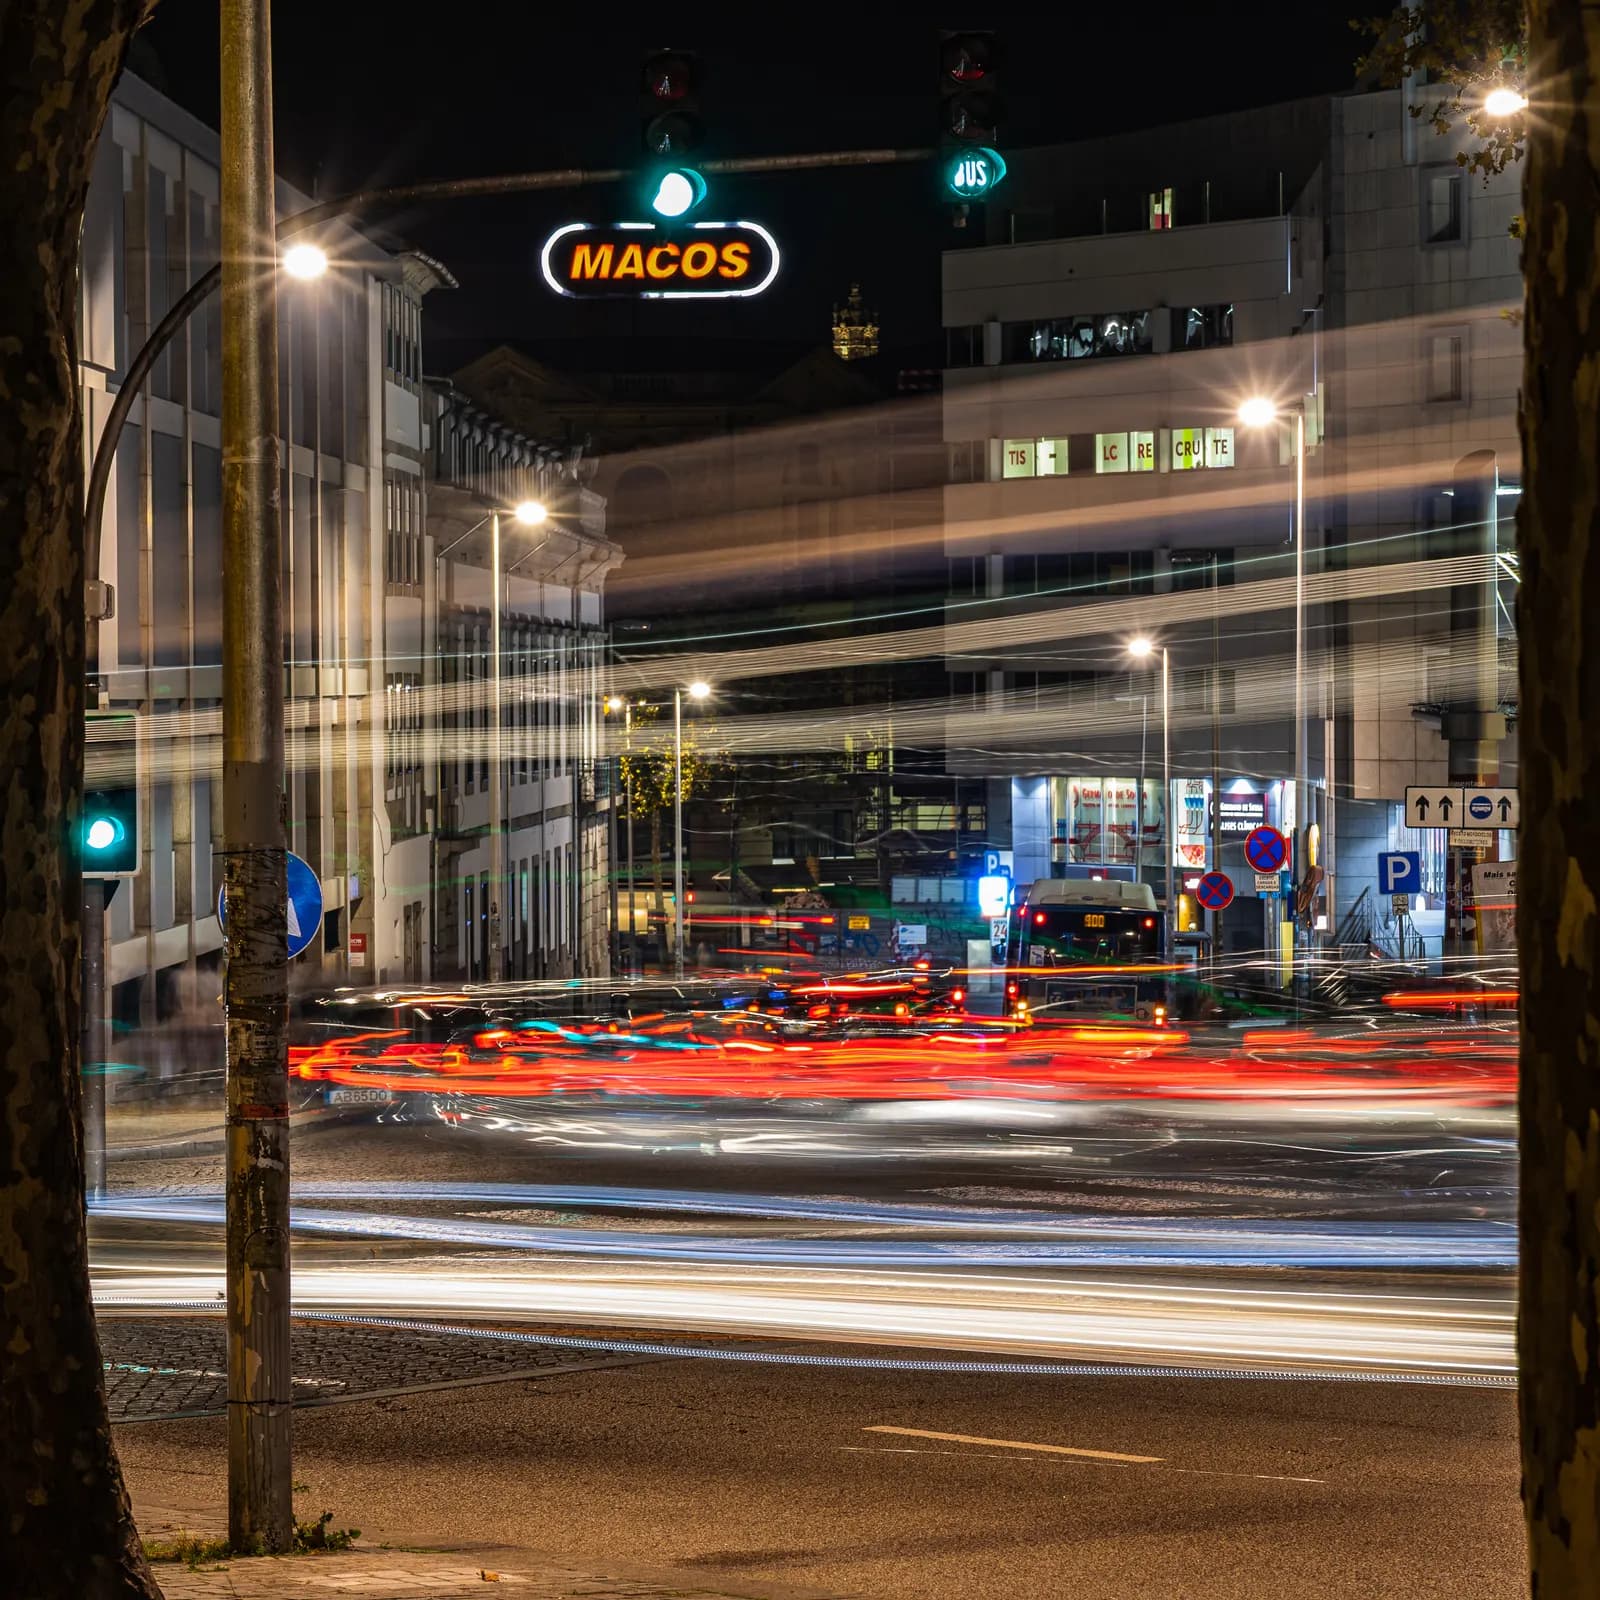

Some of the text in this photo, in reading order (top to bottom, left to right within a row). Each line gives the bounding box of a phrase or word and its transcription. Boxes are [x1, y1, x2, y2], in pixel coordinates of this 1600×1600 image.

[570, 242, 750, 279] MACOS
[1008, 450, 1026, 465] TIS
[1103, 445, 1118, 461] LC
[988, 855, 998, 875] P
[1387, 856, 1411, 890] P
[1483, 871, 1504, 879] Mais
[1084, 914, 1105, 928] 900
